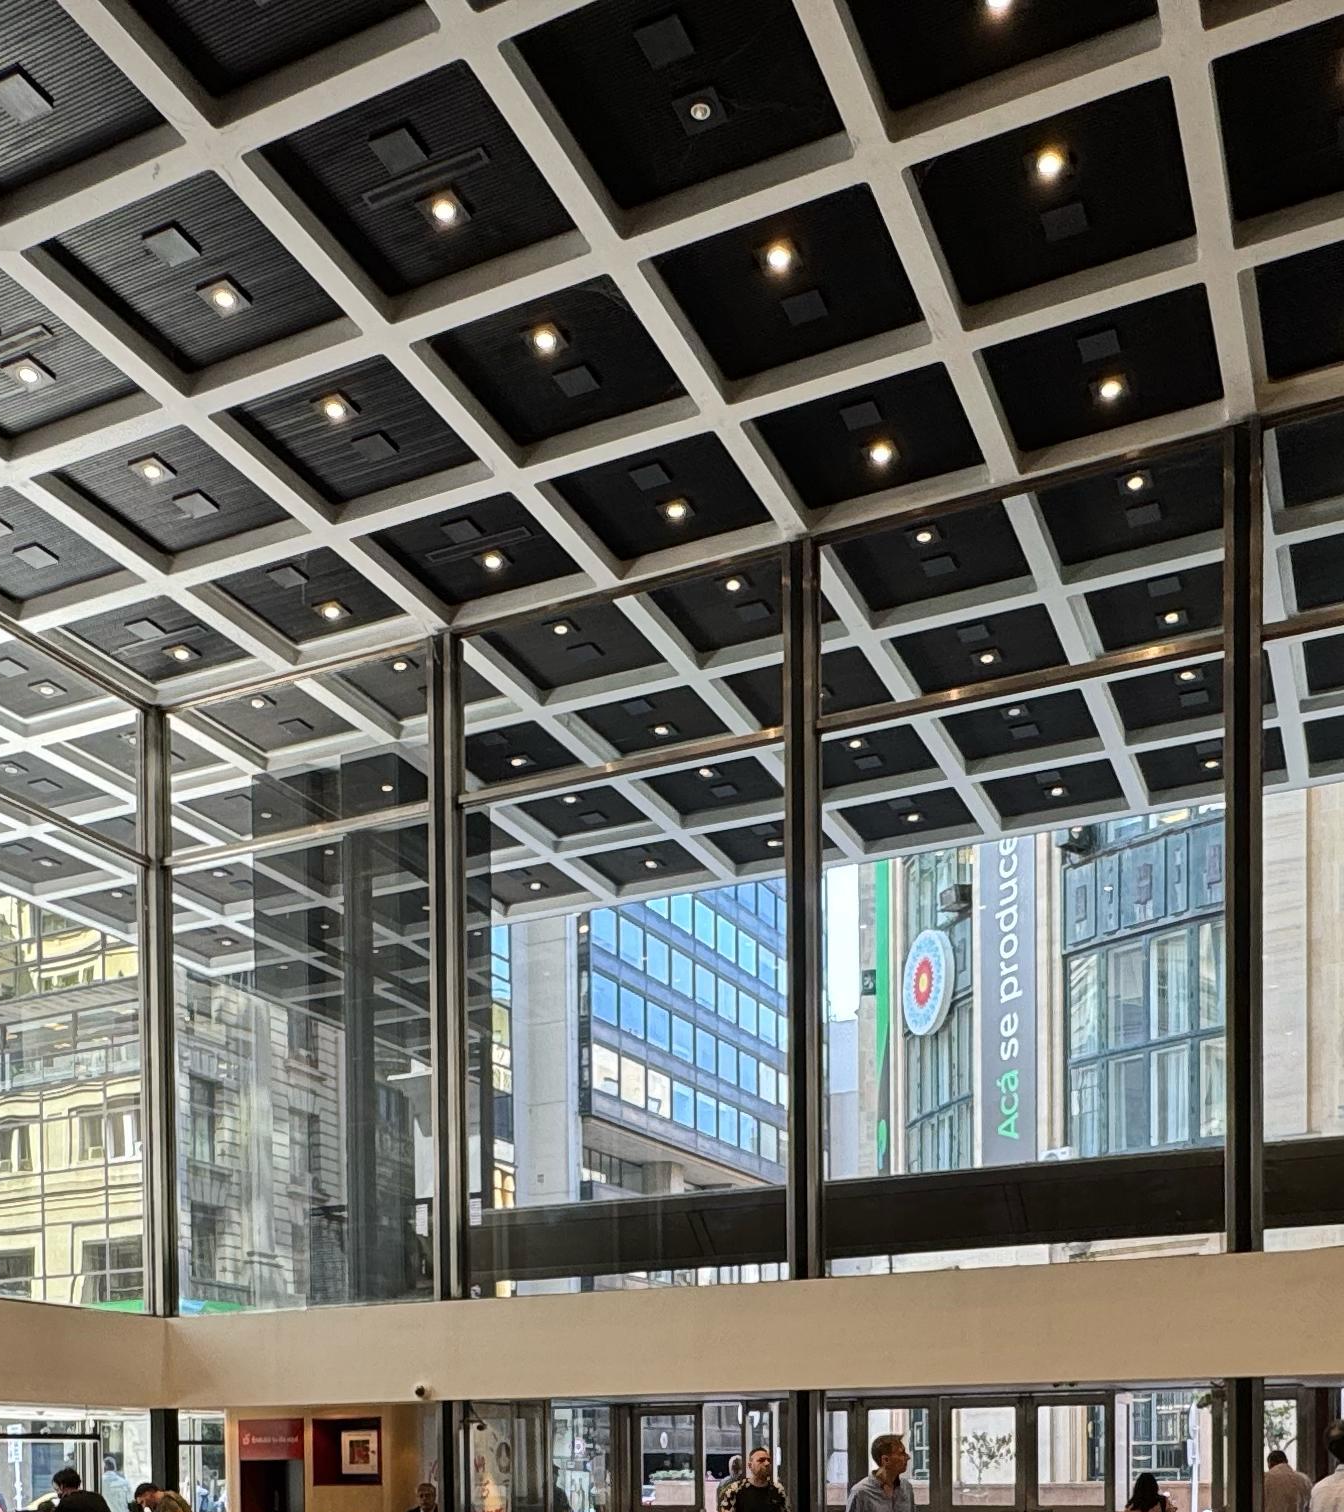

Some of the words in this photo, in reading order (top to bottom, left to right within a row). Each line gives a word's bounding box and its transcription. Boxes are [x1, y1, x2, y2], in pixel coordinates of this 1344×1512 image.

[995, 837, 1022, 1005] produce
[1000, 1011, 1019, 1061] se
[996, 1068, 1020, 1140] Acá
